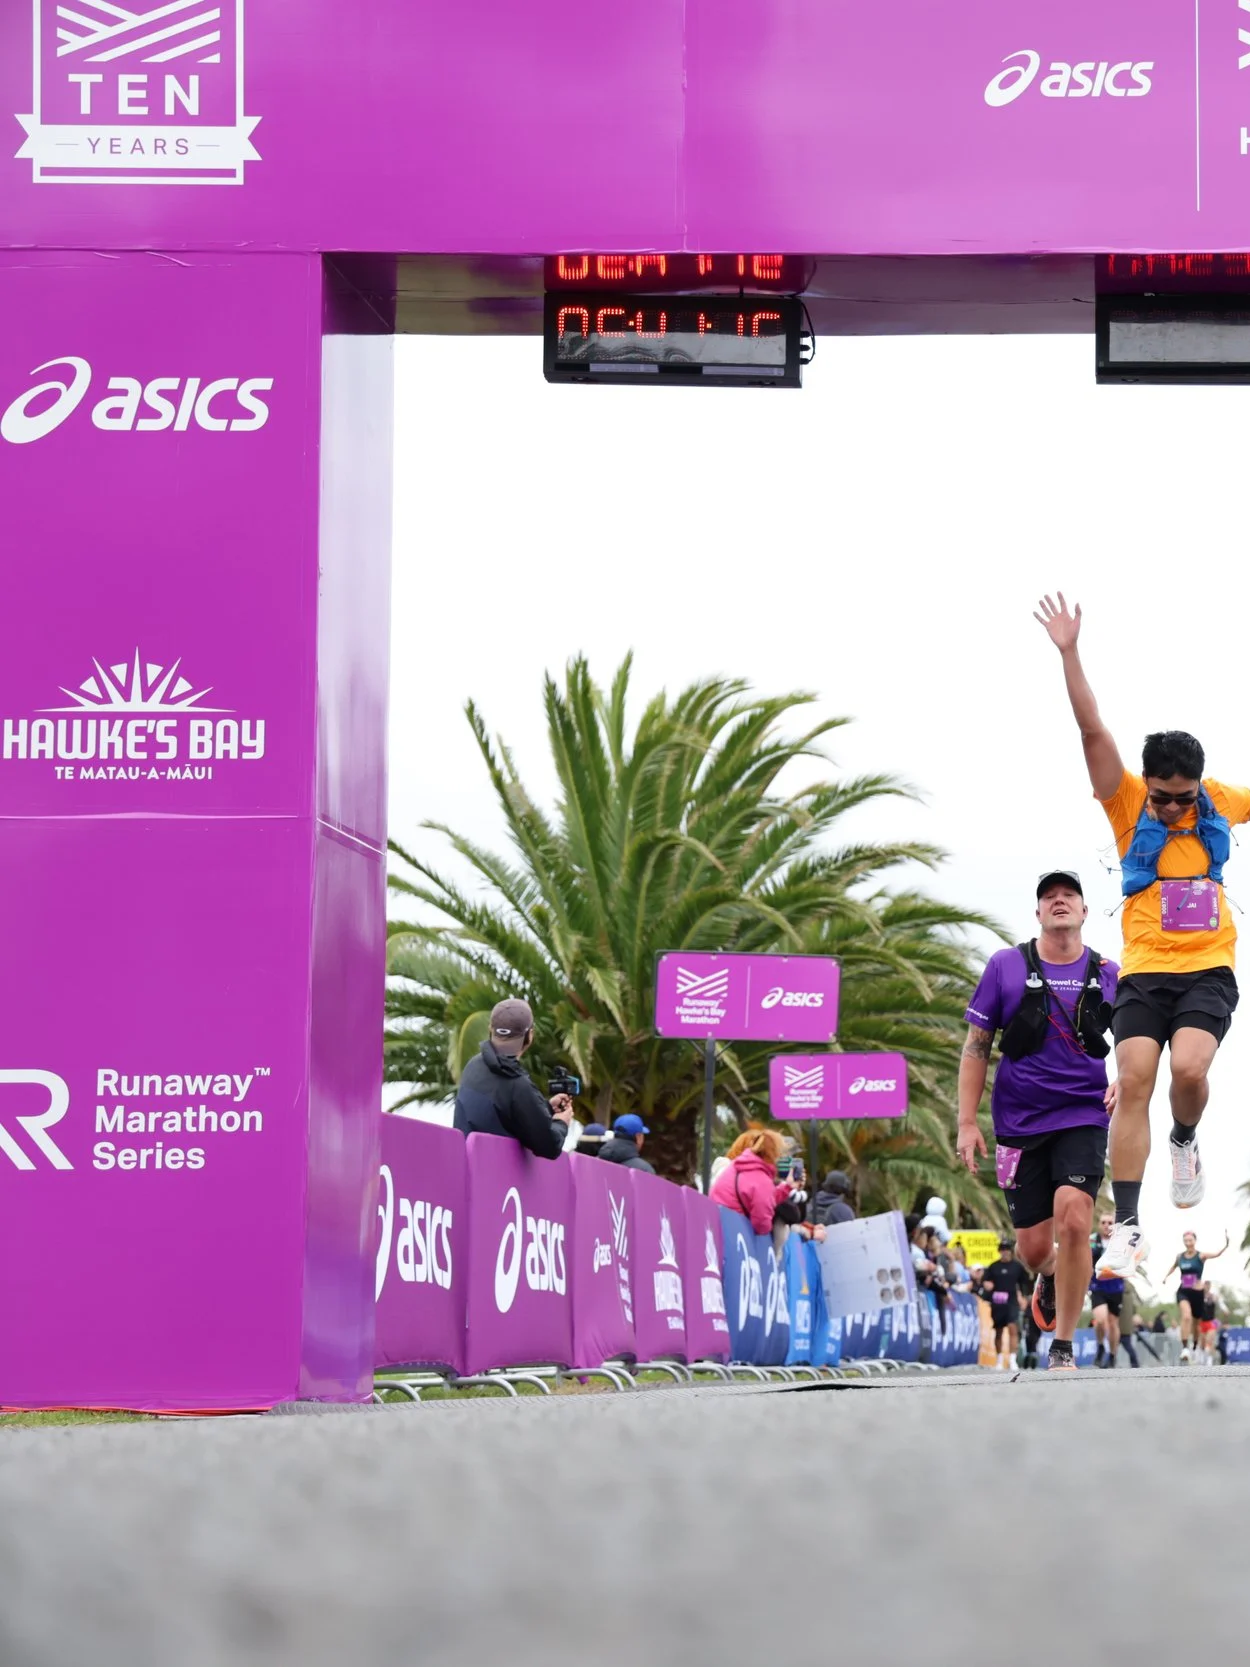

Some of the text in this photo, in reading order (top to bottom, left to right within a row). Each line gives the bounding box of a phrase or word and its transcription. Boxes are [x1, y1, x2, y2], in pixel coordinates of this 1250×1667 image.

[68, 74, 199, 116] TEN
[87, 137, 189, 156] YEARS
[2, 718, 265, 761] HAWKE'S BAY
[54, 763, 213, 780] TE MATAU-A-MĀUI
[95, 1104, 263, 1133] Marathon
[92, 1141, 205, 1171] Series
